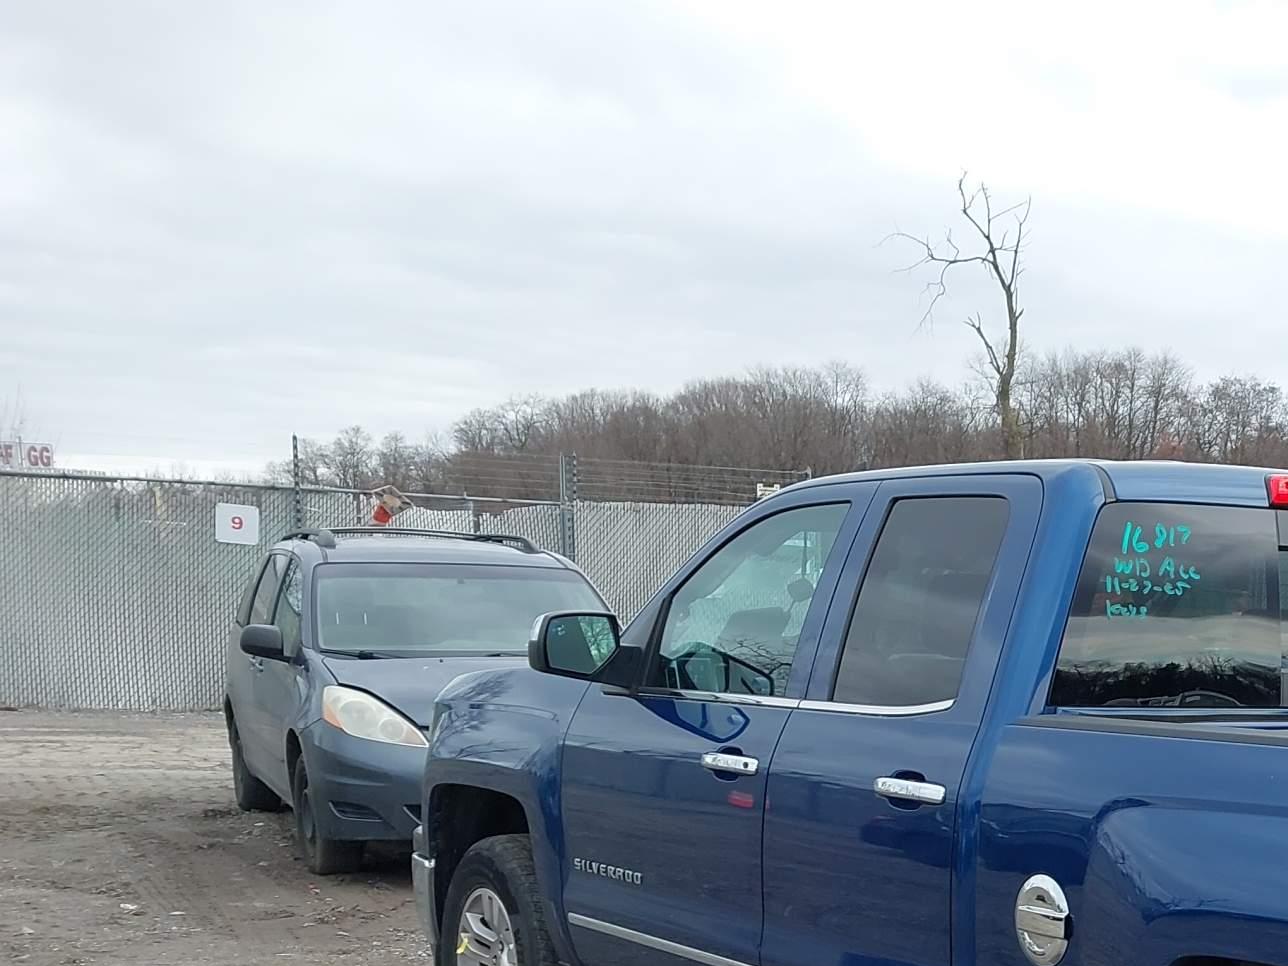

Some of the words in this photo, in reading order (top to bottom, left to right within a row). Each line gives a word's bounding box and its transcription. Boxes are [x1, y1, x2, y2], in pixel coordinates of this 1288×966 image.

[27, 445, 51, 467] GG
[231, 516, 243, 530] 9
[573, 857, 642, 885] SILVERADO
